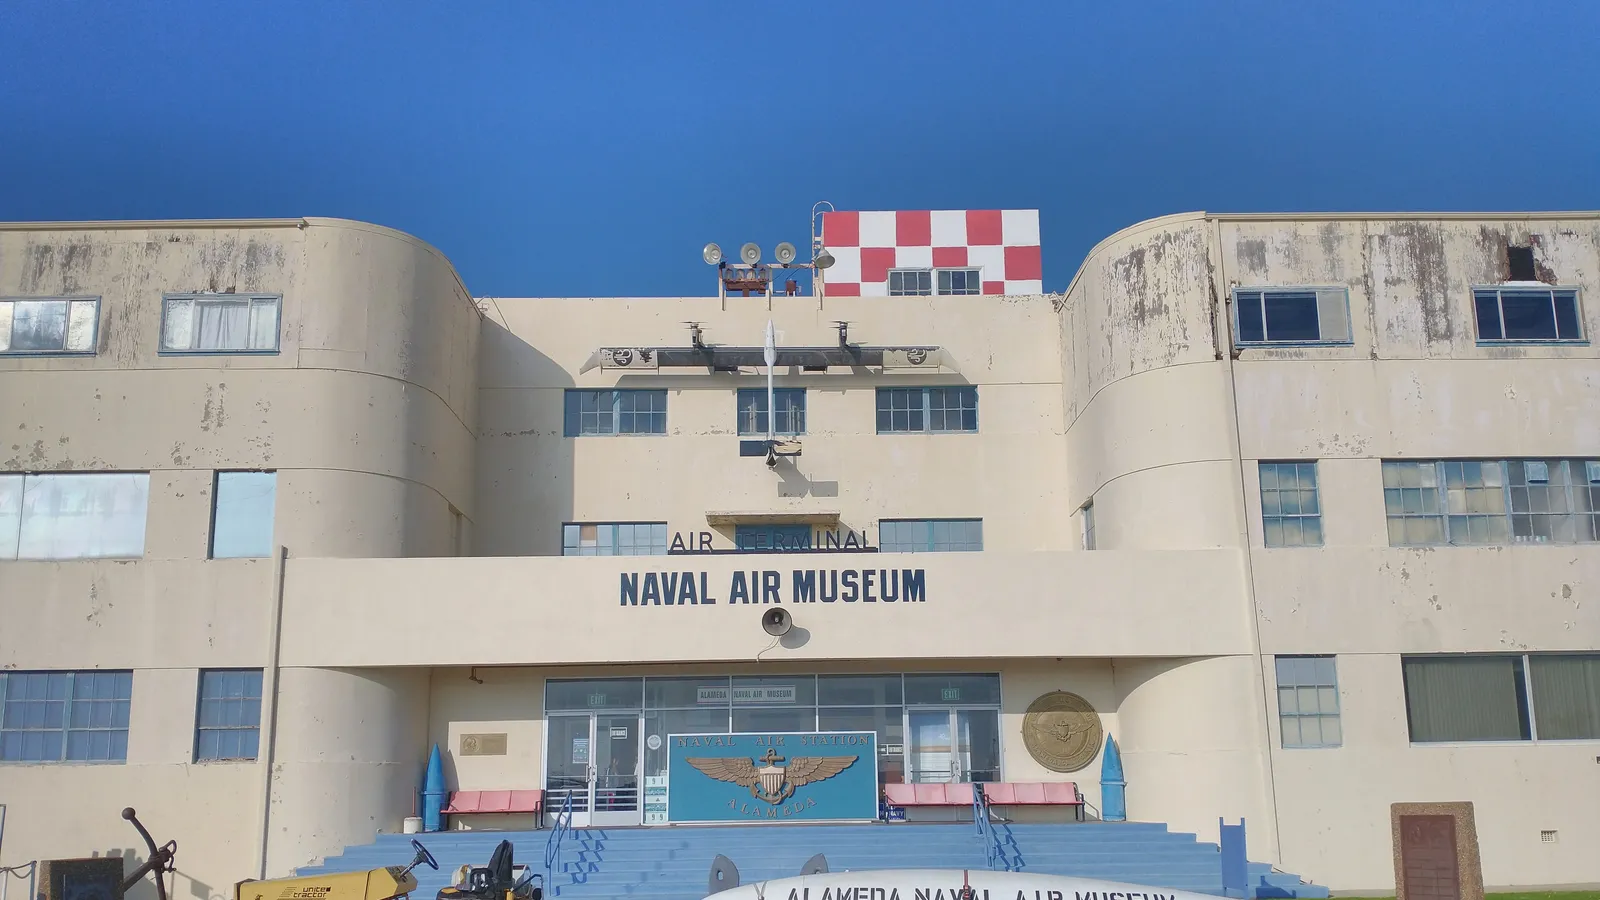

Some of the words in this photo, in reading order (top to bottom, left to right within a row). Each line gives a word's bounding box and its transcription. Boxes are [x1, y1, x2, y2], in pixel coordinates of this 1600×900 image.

[670, 531, 714, 551] AIR
[736, 528, 877, 550] TERMINAL
[620, 571, 716, 606] NAVAL
[729, 570, 781, 605] AIR
[792, 569, 926, 603] MUSEUM
[590, 695, 605, 705] EXIT
[700, 691, 727, 699] ALAMEDA
[733, 690, 751, 698] NAVAL
[752, 690, 763, 698] AIR
[766, 689, 792, 698] MUSEUM
[944, 689, 958, 699] EXIT
[678, 735, 737, 747] NAVAL
[754, 735, 785, 746] AIR
[801, 735, 870, 746] STATION
[728, 797, 817, 818] ALAMEDA
[787, 887, 901, 900] ALAMEDA
